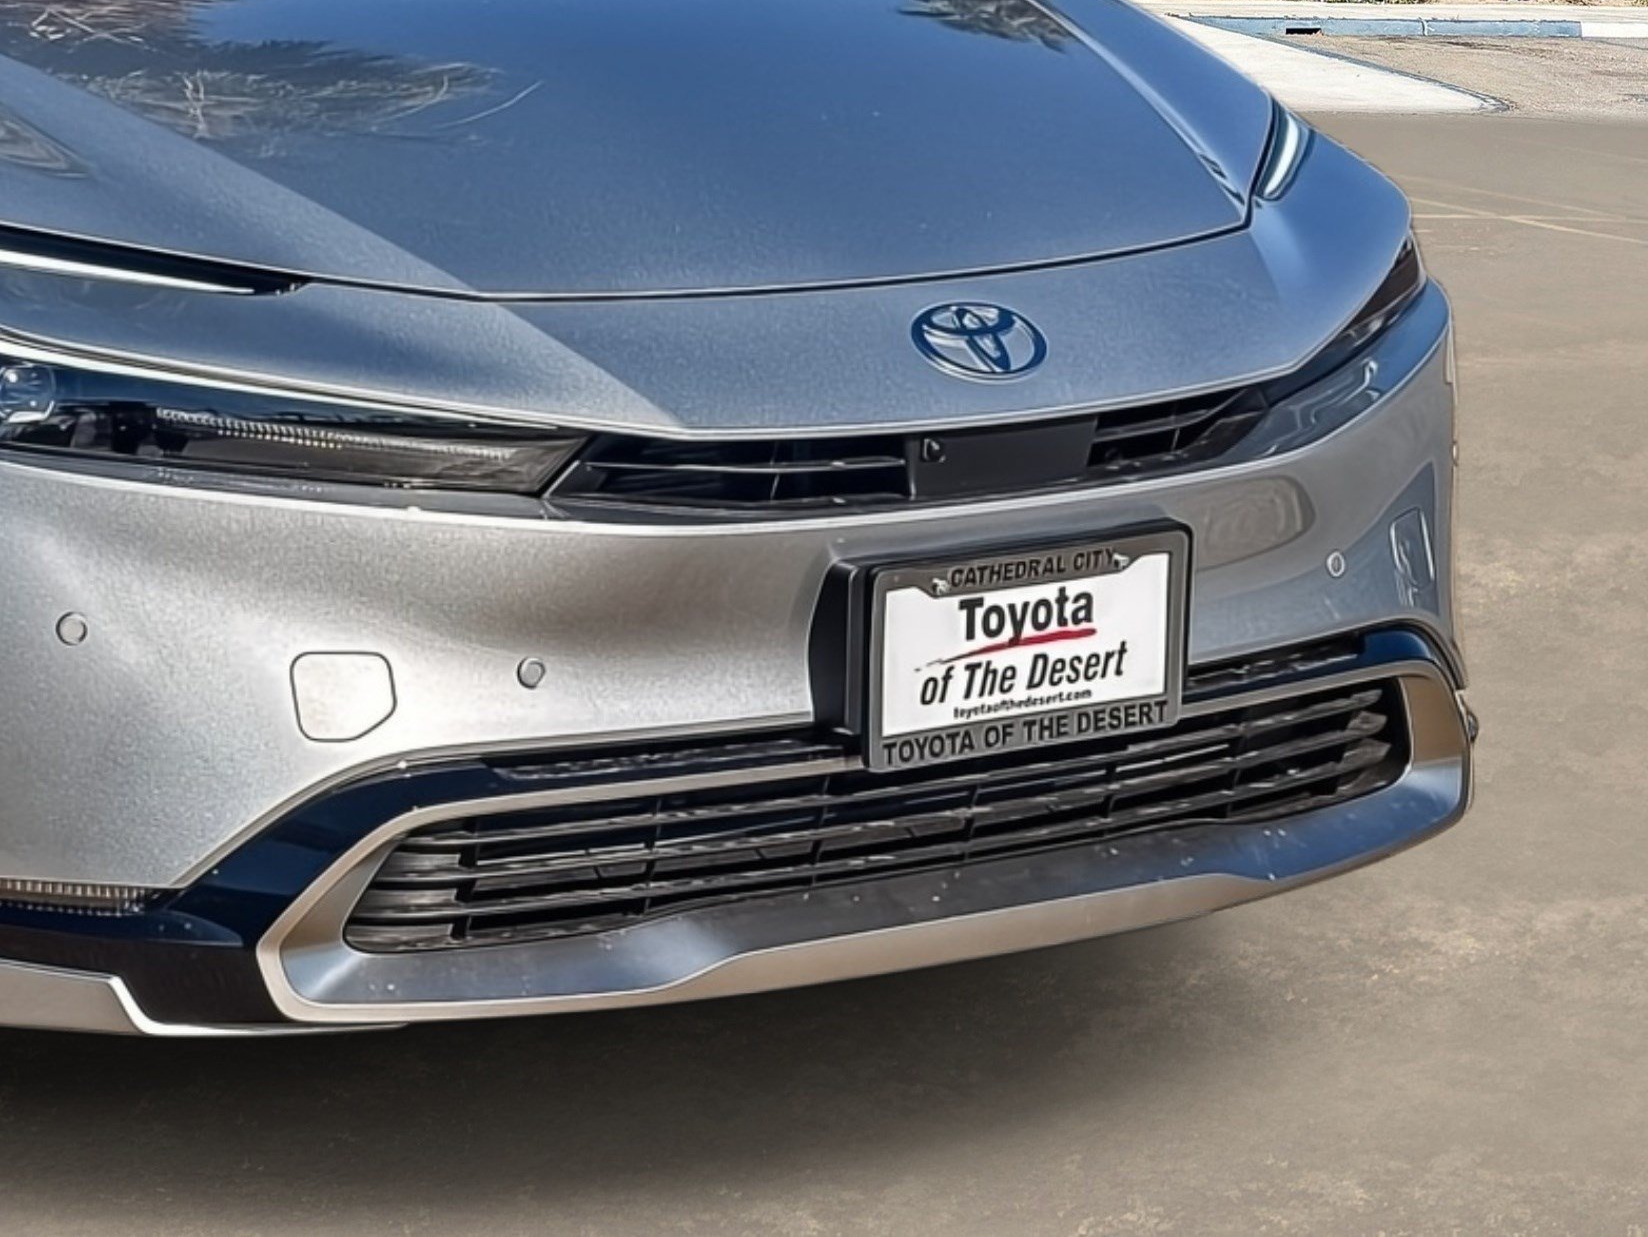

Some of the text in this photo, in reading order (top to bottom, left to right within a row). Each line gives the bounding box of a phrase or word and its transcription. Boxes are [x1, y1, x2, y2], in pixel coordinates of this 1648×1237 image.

[950, 547, 1116, 588] CATHEDRAL CITY
[958, 586, 1094, 646] Toyota
[920, 640, 1128, 705] of The Desert
[882, 700, 1169, 766] TOYOTA OF THE DESERT
[953, 689, 1093, 720] toyotaofthedesert.com
